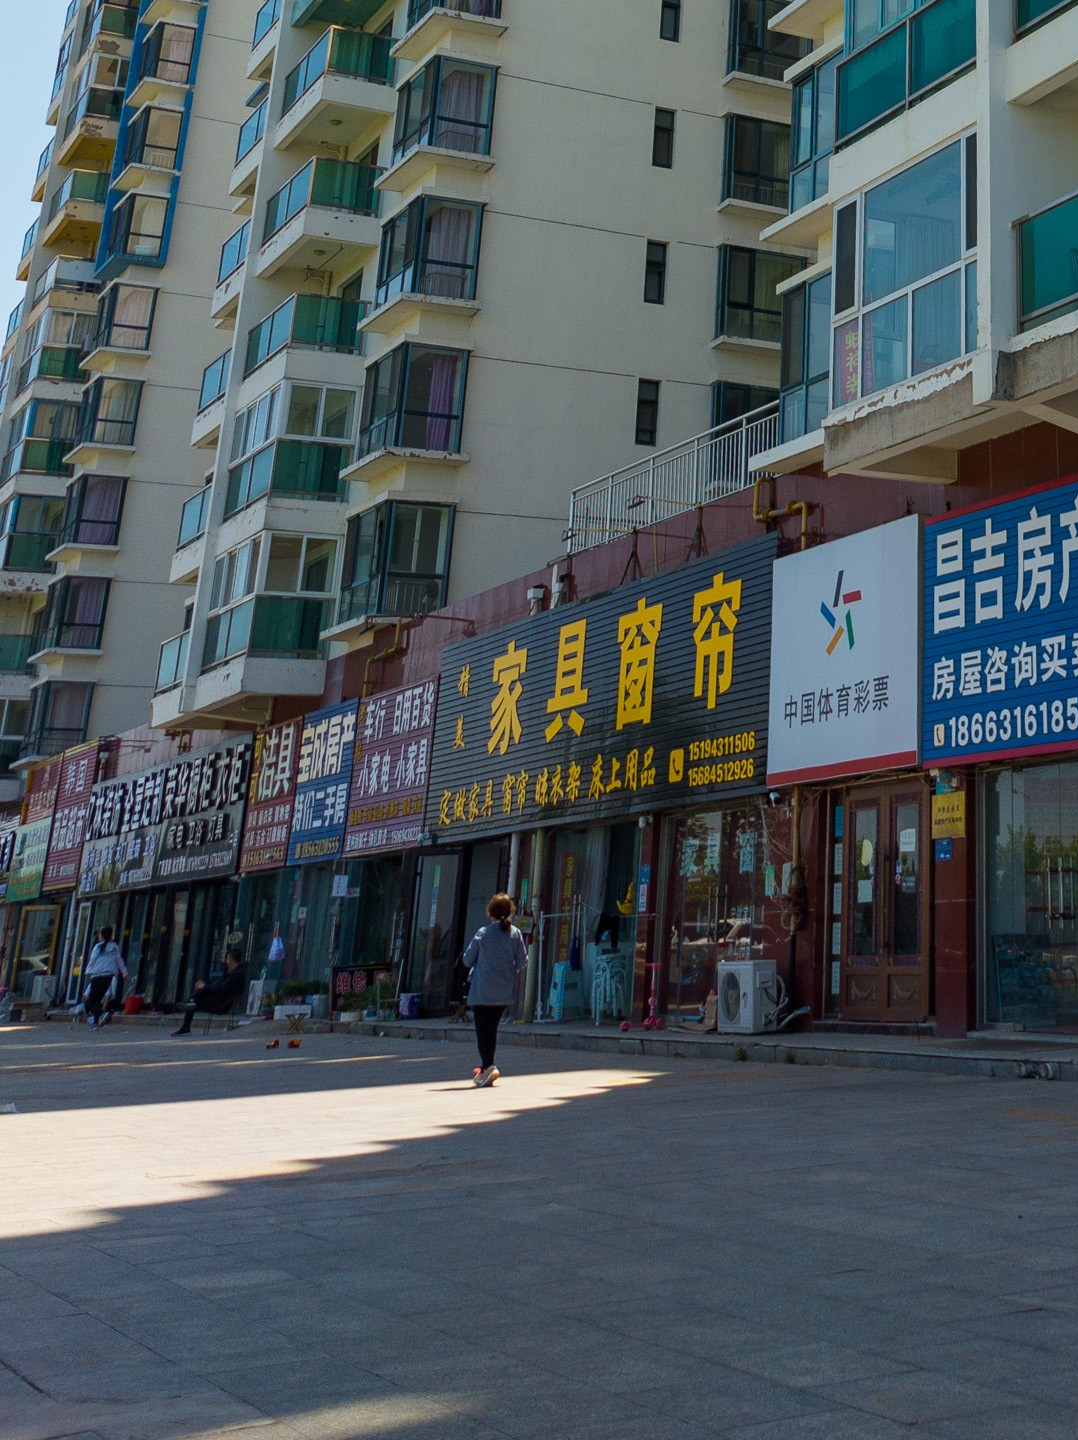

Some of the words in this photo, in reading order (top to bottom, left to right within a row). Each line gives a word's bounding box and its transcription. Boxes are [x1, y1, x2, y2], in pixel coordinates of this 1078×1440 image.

[487, 571, 743, 756] 家具窗帘
[392, 681, 435, 736] 日用百货
[783, 675, 890, 730] 中国体育彩票
[358, 748, 391, 799] 小家电
[394, 738, 428, 791] 小家具
[688, 731, 756, 761] 15194311506
[688, 759, 755, 788] 15684512926
[292, 782, 348, 833] 特价二手房
[439, 774, 494, 826] 定做家具
[502, 768, 529, 816] 窗帘
[535, 761, 580, 808] 晾衣架
[588, 747, 656, 800] 床上用品
[335, 970, 367, 995] 维修
